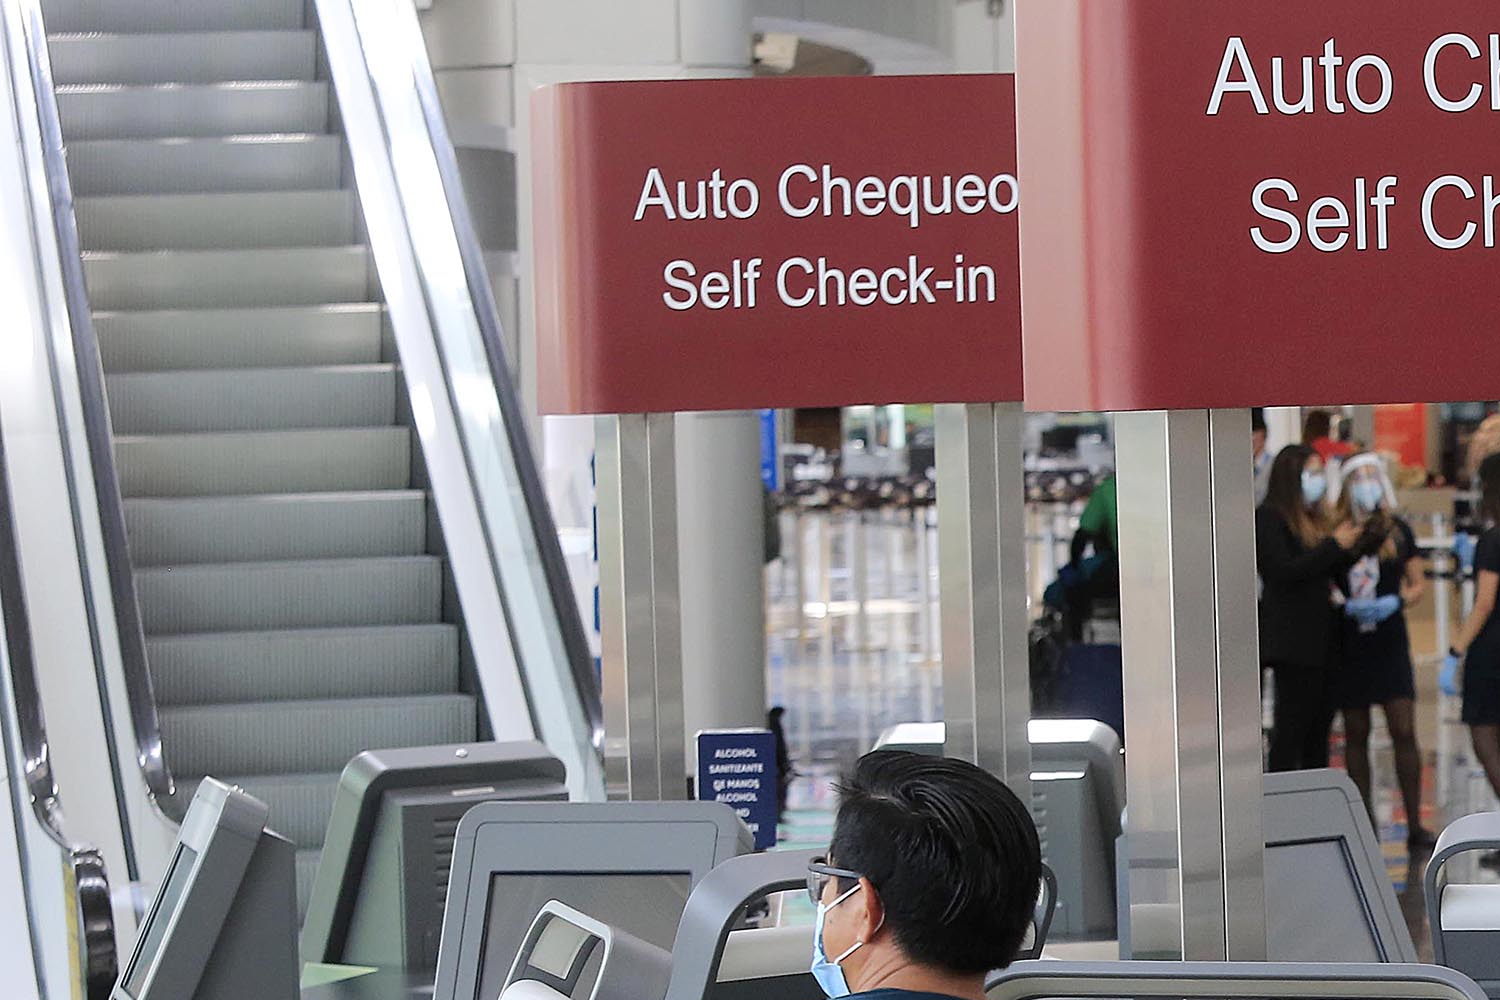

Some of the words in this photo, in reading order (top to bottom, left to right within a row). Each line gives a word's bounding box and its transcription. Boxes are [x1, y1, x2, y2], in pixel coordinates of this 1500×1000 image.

[1207, 37, 1393, 115] Auto
[634, 168, 760, 221] Auto
[778, 164, 1019, 228] Chequeo
[1250, 176, 1397, 253] Self
[663, 258, 762, 310] Self
[776, 254, 996, 307] Check-in
[709, 763, 764, 774] SANITIZANTE
[715, 748, 757, 758] ALCOHOL
[715, 793, 758, 802] ALCOHOL
[727, 779, 760, 789] MANOS
